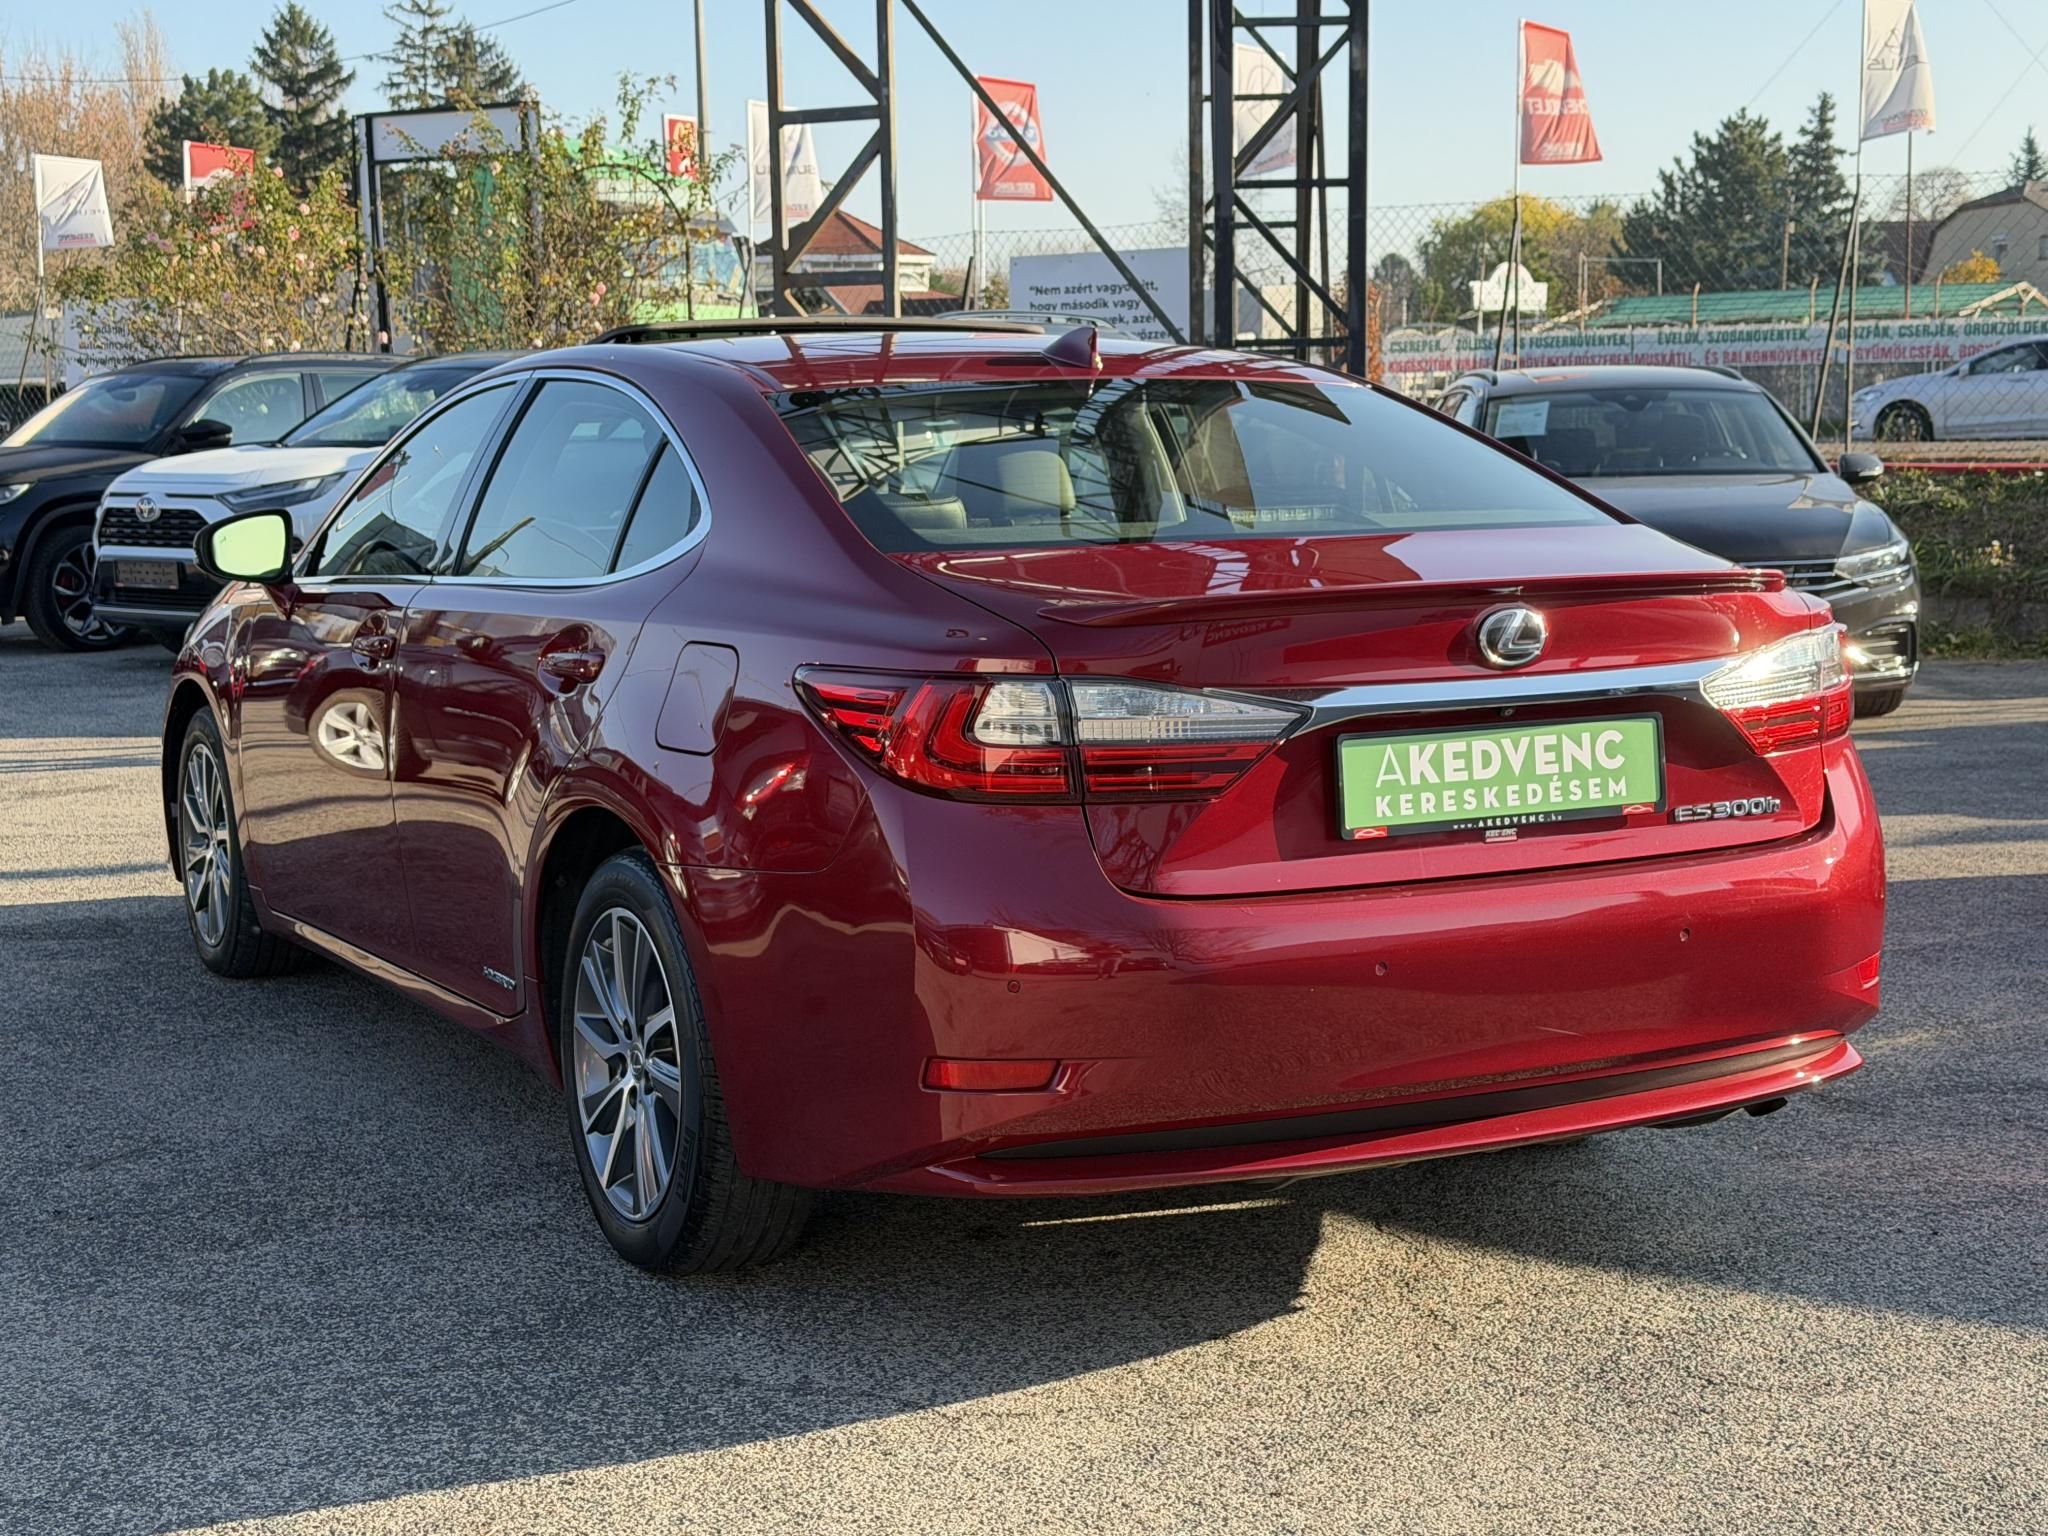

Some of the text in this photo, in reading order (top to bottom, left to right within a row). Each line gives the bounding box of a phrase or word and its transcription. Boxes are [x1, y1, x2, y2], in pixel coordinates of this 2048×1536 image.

[1064, 283, 1093, 295] azért
[1096, 284, 1136, 295] vagyo
[1061, 298, 1109, 310] második
[1112, 299, 1141, 310] vagy
[1375, 775, 1627, 818] KERESKEDÉSEM
